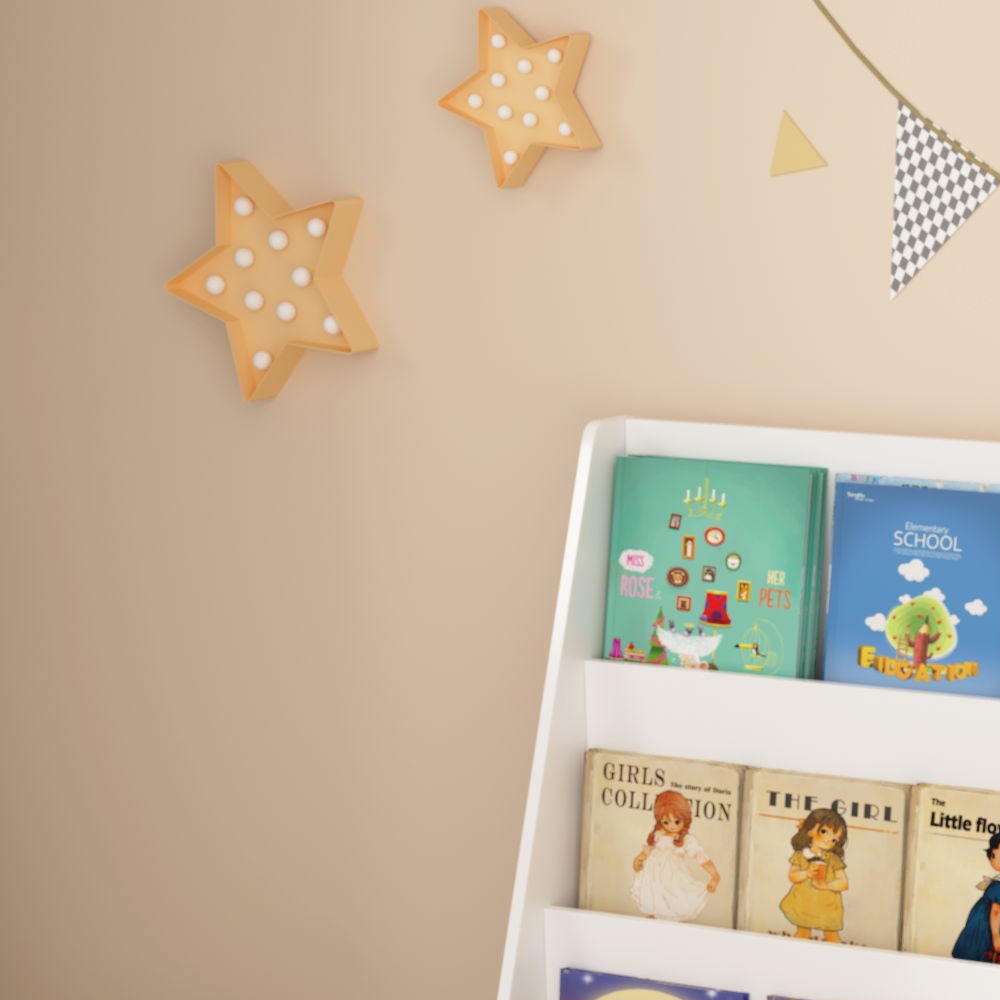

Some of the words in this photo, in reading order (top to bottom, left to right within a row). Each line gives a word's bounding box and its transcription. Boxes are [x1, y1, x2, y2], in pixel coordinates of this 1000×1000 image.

[905, 521, 949, 534] Elementary
[893, 530, 962, 552] SCHOOL
[626, 554, 645, 567] MISS
[619, 574, 655, 599] ROSE
[766, 569, 786, 586] HER
[758, 587, 791, 609] PETS
[603, 761, 665, 788] GIRLS
[670, 781, 682, 789] The
[684, 784, 702, 793] story
[601, 786, 732, 822] COLLION
[766, 790, 819, 811] THE
[831, 798, 898, 824] GIRL
[931, 798, 945, 807] The
[930, 811, 972, 832] Little
